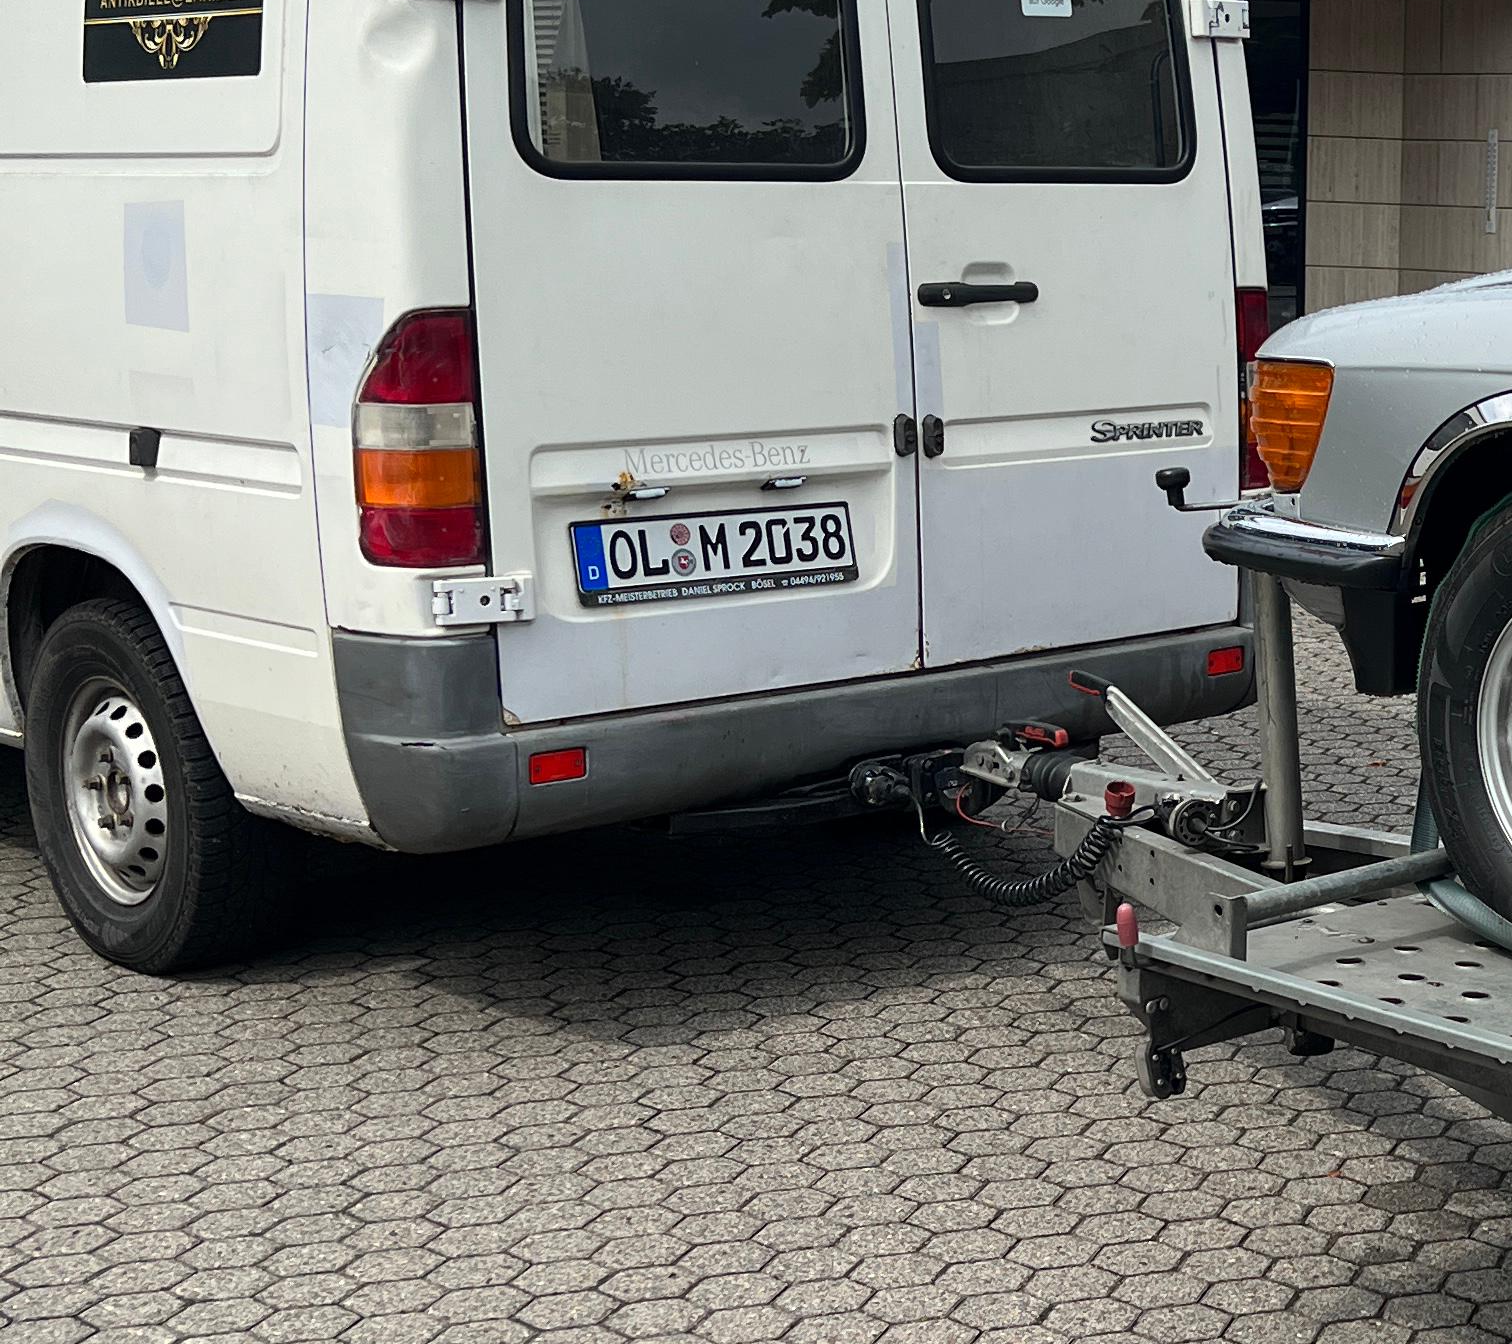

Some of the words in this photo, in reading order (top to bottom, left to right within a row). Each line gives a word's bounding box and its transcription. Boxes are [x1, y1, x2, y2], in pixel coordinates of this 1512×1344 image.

[1090, 419, 1204, 443] SPRINTER
[623, 441, 811, 475] Mercedes-Benz
[588, 565, 600, 581] D
[609, 529, 670, 579] OL
[698, 522, 731, 572] M
[738, 513, 846, 568] 2038
[598, 588, 679, 604] KFZ-MEISTERBETRIEB
[681, 584, 712, 597] DANIEL
[712, 581, 746, 594] SPROCK
[751, 578, 776, 590] BÖSEL
